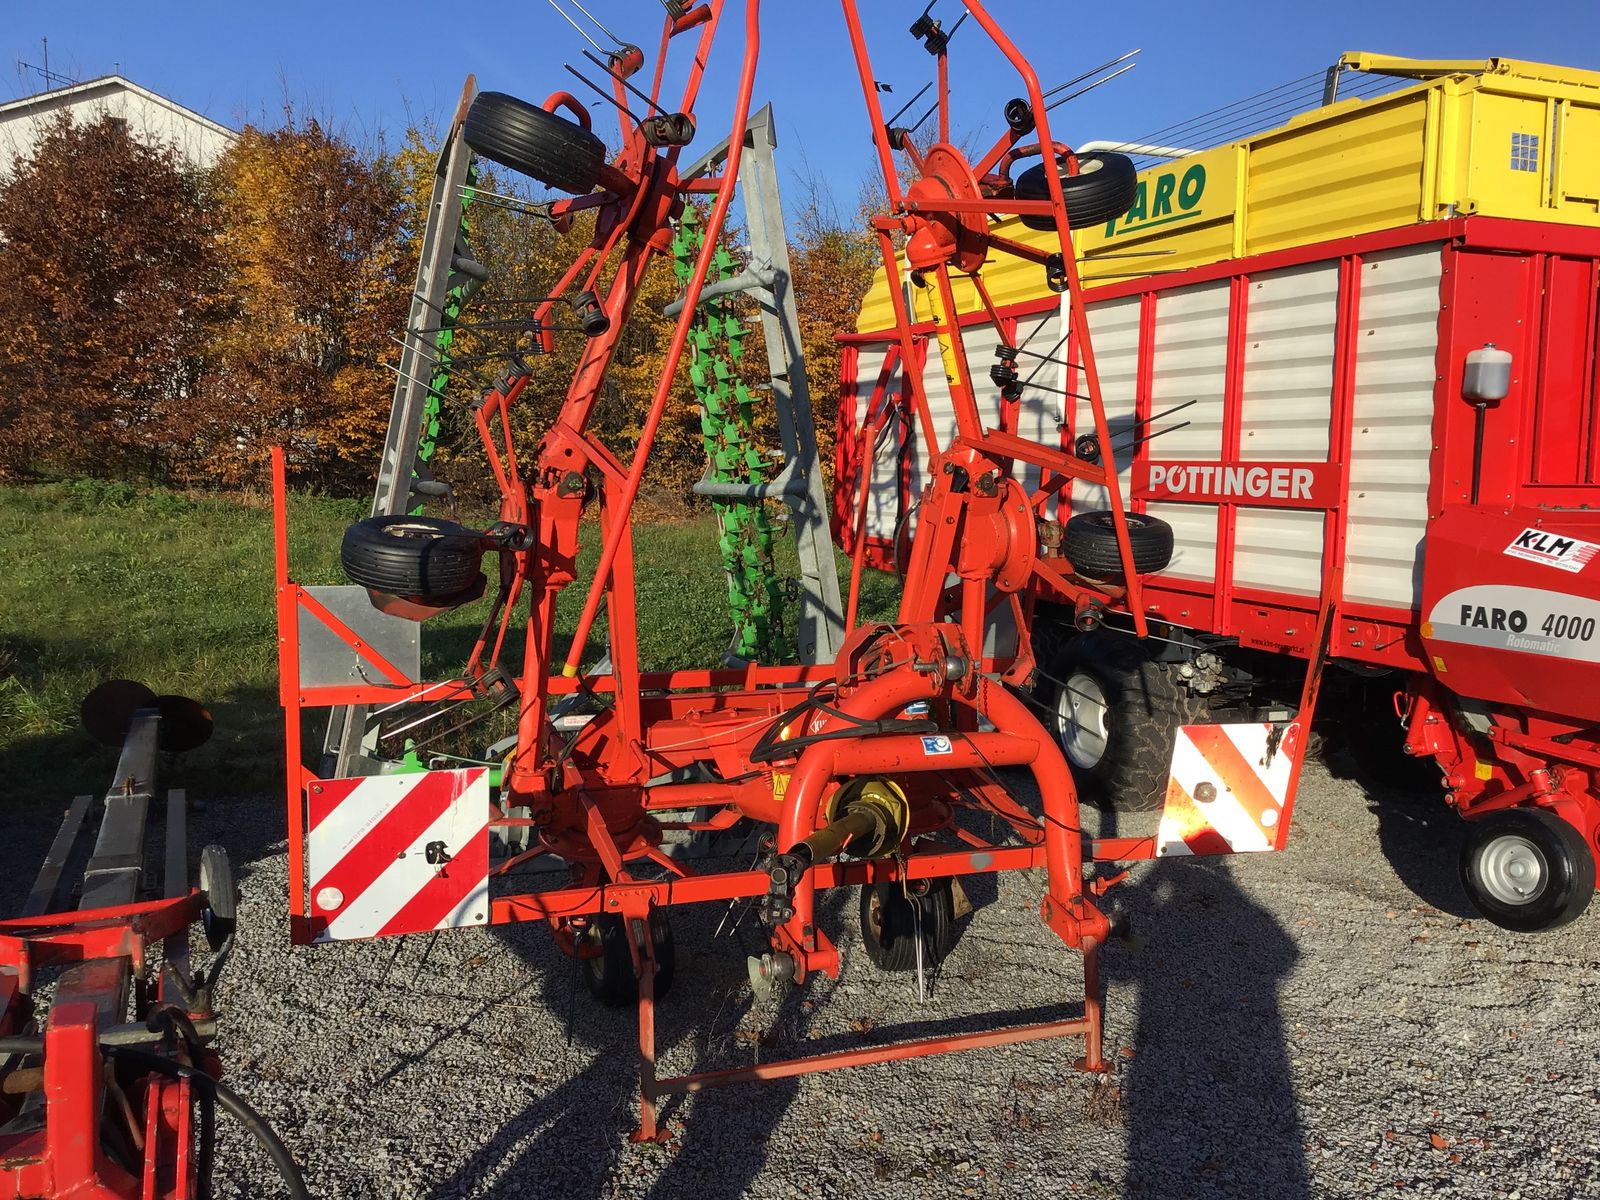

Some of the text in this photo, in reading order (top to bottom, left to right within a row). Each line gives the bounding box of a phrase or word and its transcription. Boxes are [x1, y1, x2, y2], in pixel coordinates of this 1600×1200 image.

[1148, 465, 1314, 500] PÖTTINGER
[1460, 604, 1596, 642] FARO 4000
[1506, 634, 1560, 654] Rotomatic
